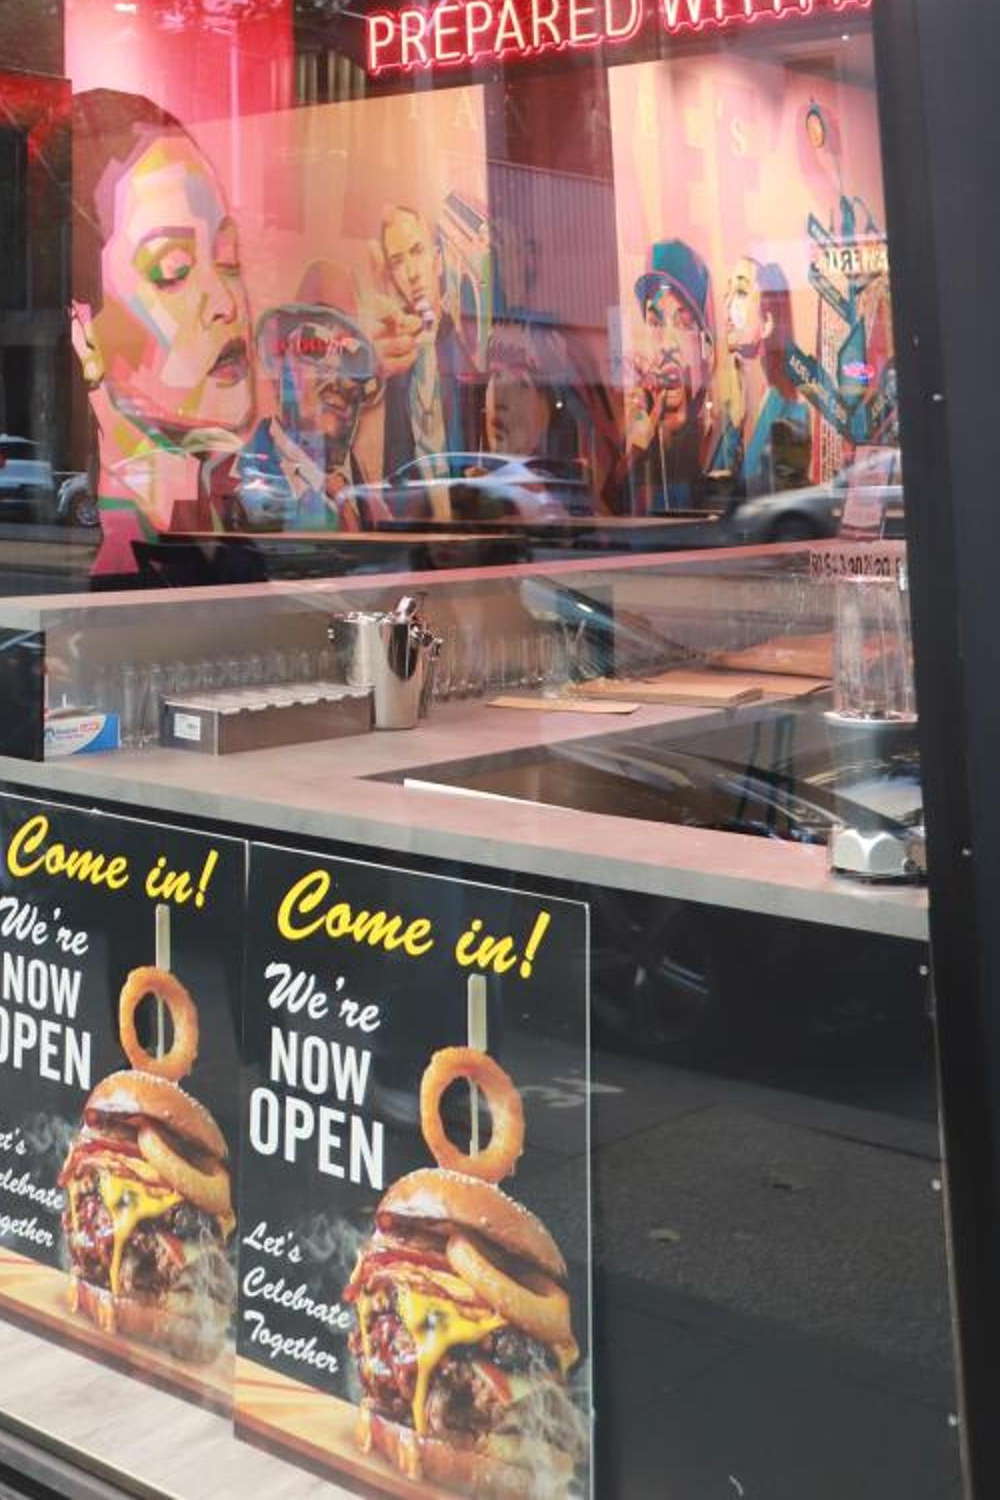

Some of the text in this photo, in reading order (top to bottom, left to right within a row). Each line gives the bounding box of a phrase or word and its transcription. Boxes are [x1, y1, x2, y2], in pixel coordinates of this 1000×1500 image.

[6, 814, 219, 908] Come in!
[276, 870, 551, 979] Come in!
[2, 951, 82, 1020] NOW
[264, 962, 382, 1033] We're
[270, 1026, 373, 1106] NOW
[248, 1087, 385, 1192] OPEN
[243, 1221, 303, 1264] Let's
[243, 1267, 352, 1331] Celebrate
[243, 1308, 339, 1373] Together
